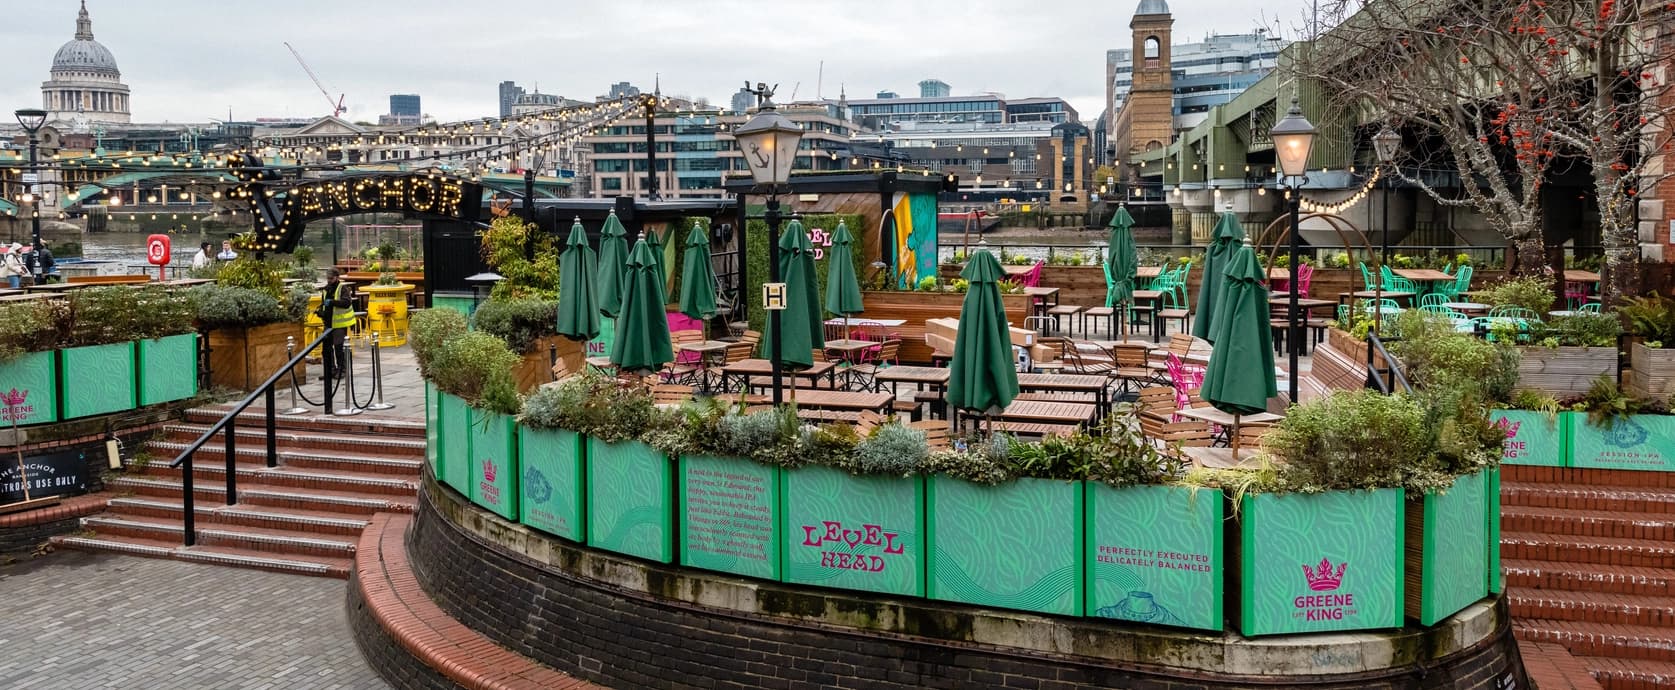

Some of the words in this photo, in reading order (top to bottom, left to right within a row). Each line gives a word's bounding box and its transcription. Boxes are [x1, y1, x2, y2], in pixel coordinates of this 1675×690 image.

[301, 178, 463, 218] ANCHOR
[766, 286, 782, 306] H
[16, 464, 55, 474] ANCHOR
[36, 479, 52, 488] USE
[56, 476, 76, 486] ONLY
[802, 521, 904, 554] LEVEL
[821, 552, 885, 572] HEAD
[1100, 546, 1152, 558] PERFECTLY
[1158, 552, 1208, 562] EXECUTED
[1098, 556, 1154, 566] DELICATELY
[1158, 561, 1210, 572] BALANCED
[1294, 594, 1352, 608] GREENE
[1306, 608, 1342, 621] KING
